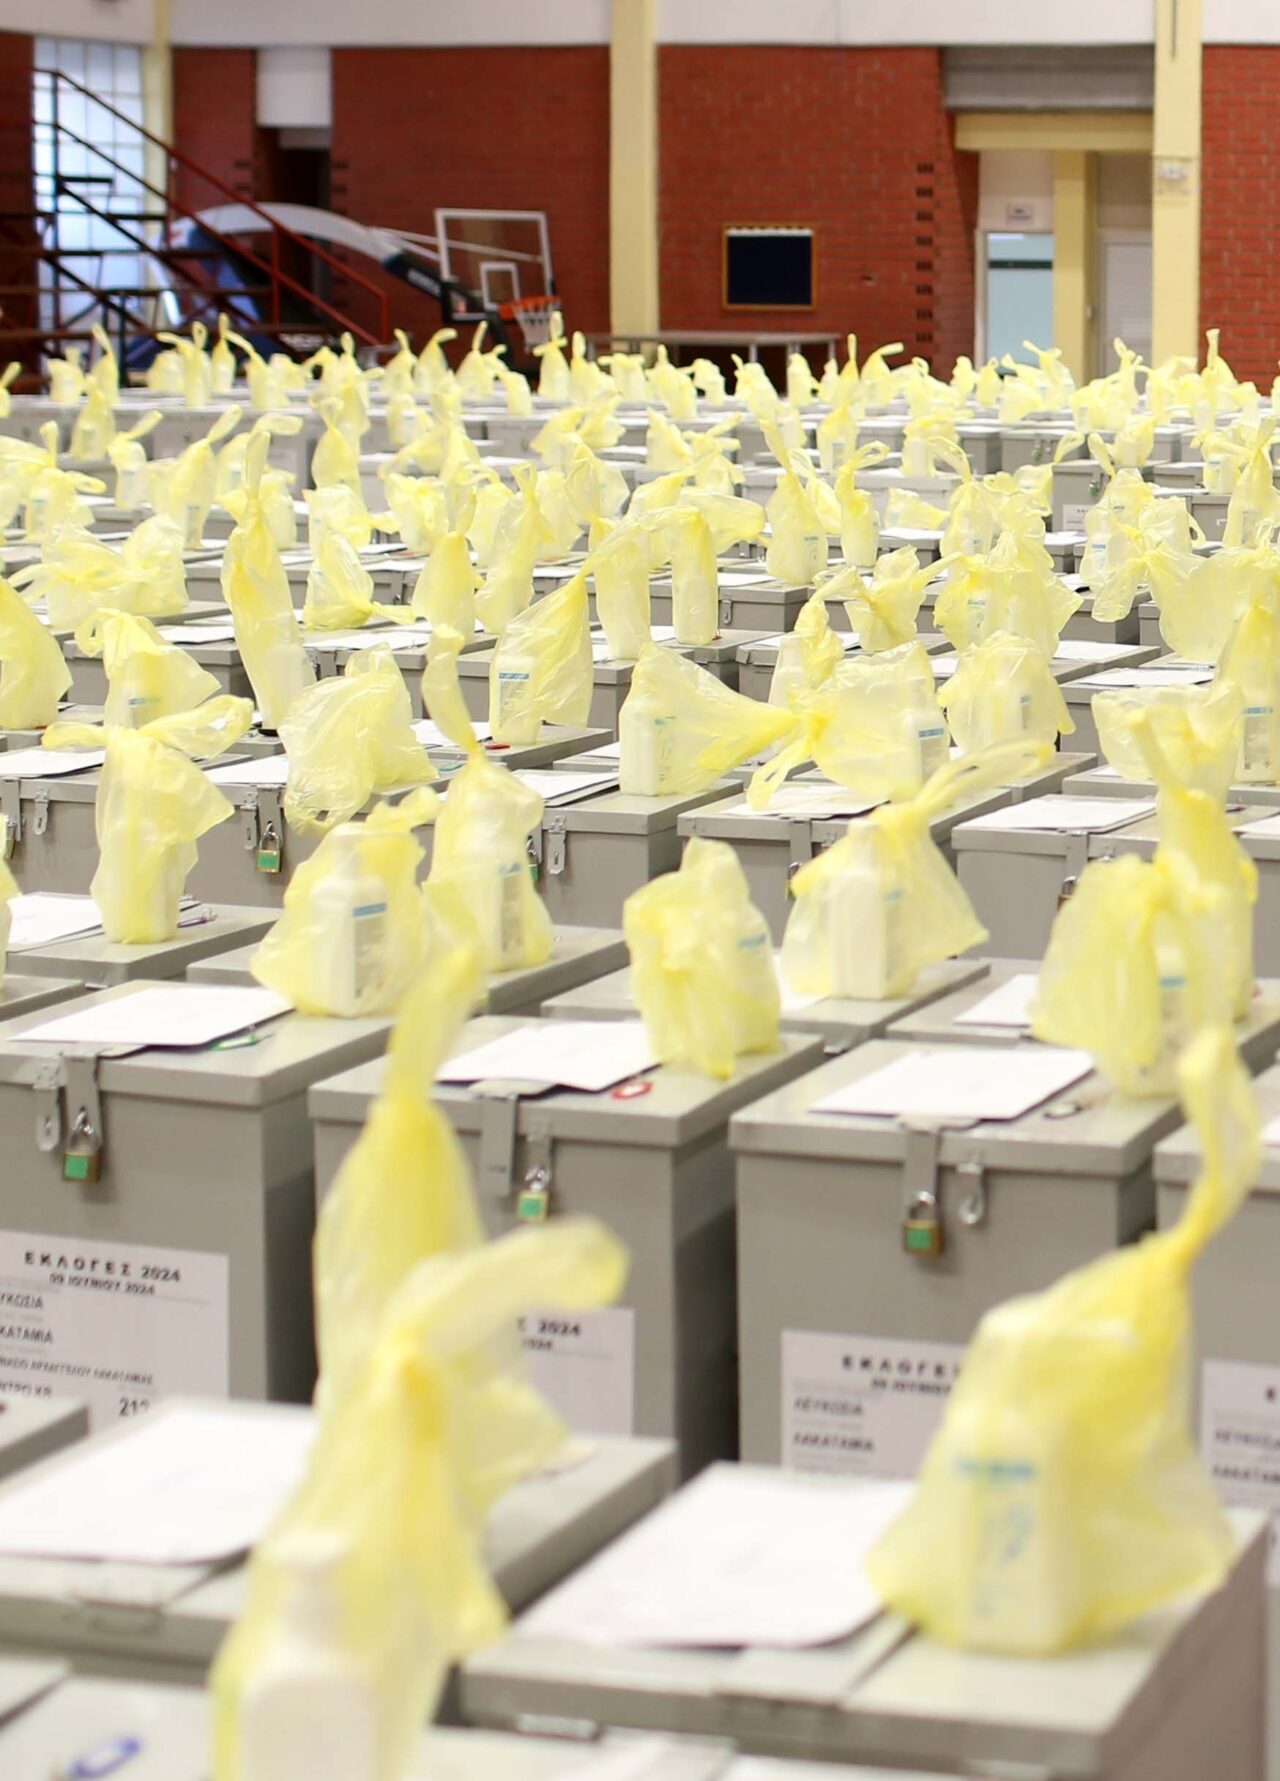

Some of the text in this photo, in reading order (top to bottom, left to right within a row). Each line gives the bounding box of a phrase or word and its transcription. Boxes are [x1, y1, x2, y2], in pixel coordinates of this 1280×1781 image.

[24, 1251, 182, 1283] ΕΚΛΟΓΕΣ 2024
[538, 1318, 581, 1336] 2024
